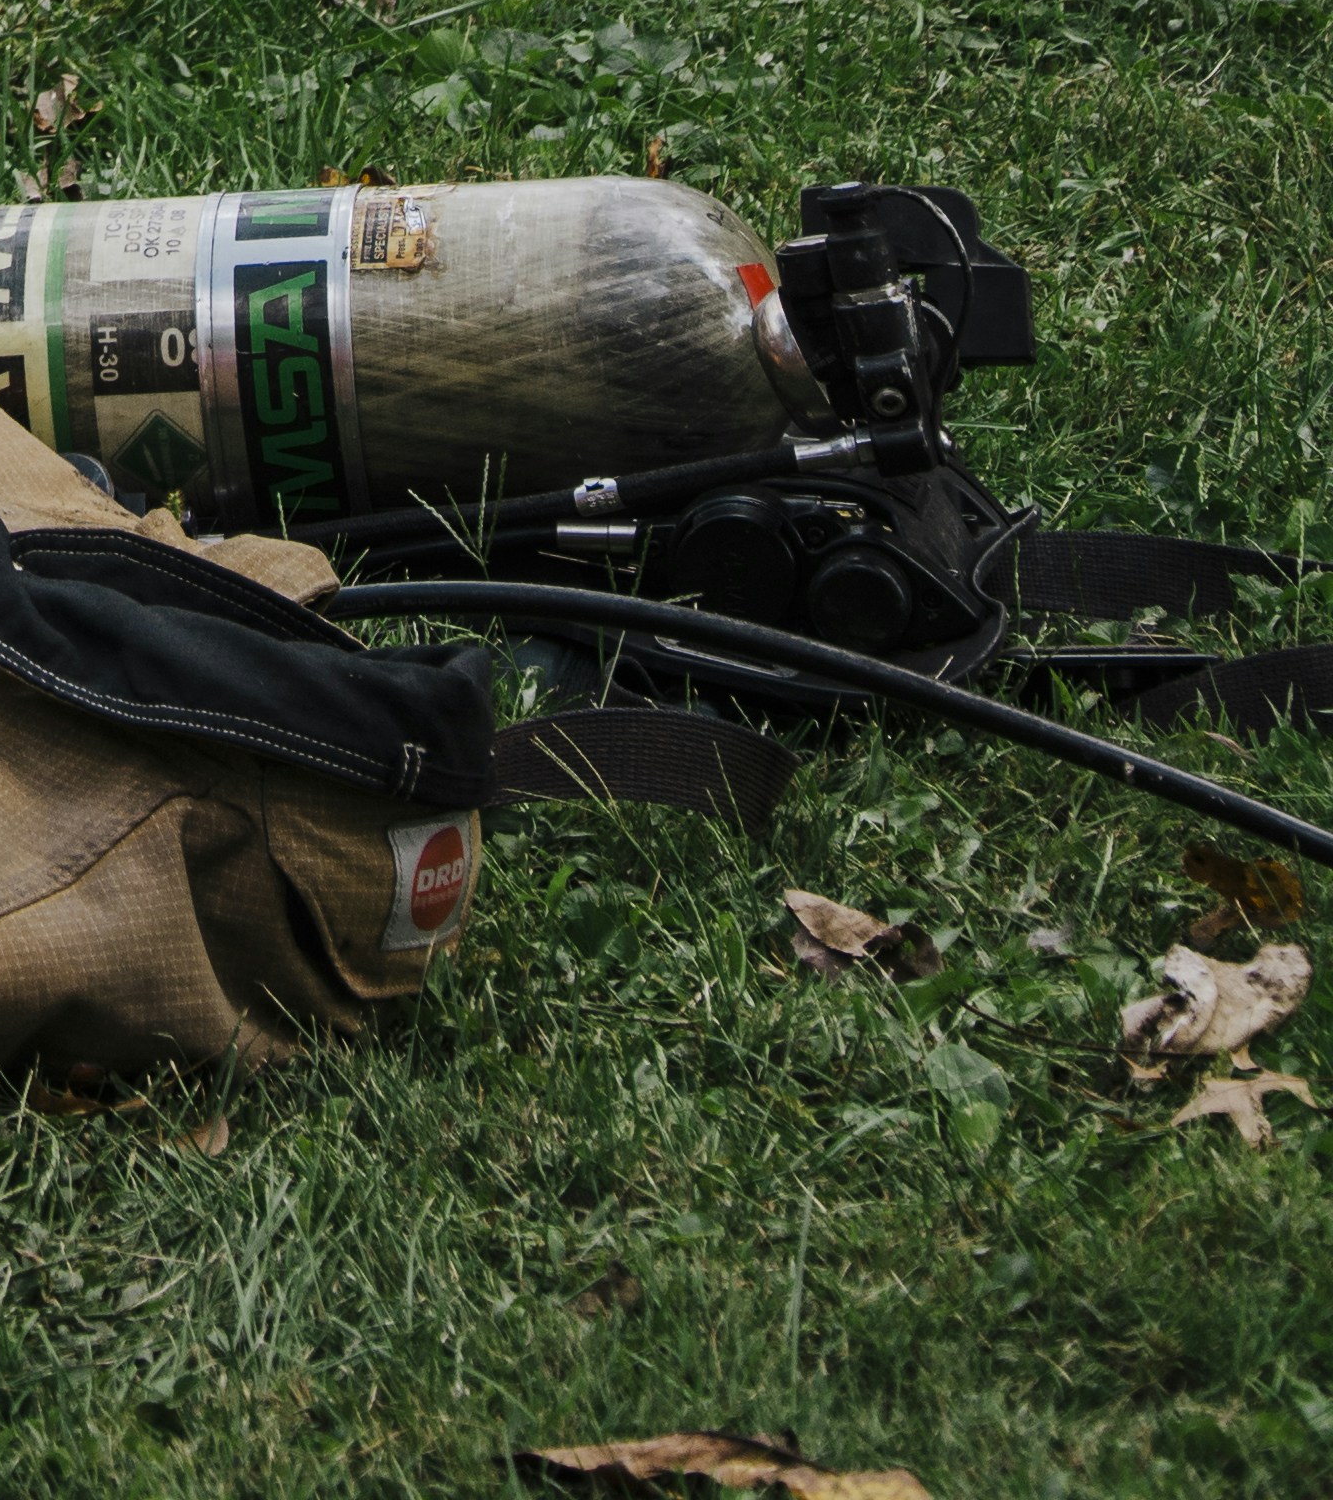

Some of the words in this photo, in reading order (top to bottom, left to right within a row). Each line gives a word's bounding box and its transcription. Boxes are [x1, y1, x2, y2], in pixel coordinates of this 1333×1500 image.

[143, 236, 159, 258] OK
[166, 239, 181, 255] 10
[414, 238, 424, 258] Date
[97, 326, 120, 382] H-30
[249, 270, 341, 512] MSA
[416, 857, 465, 893] DRD
